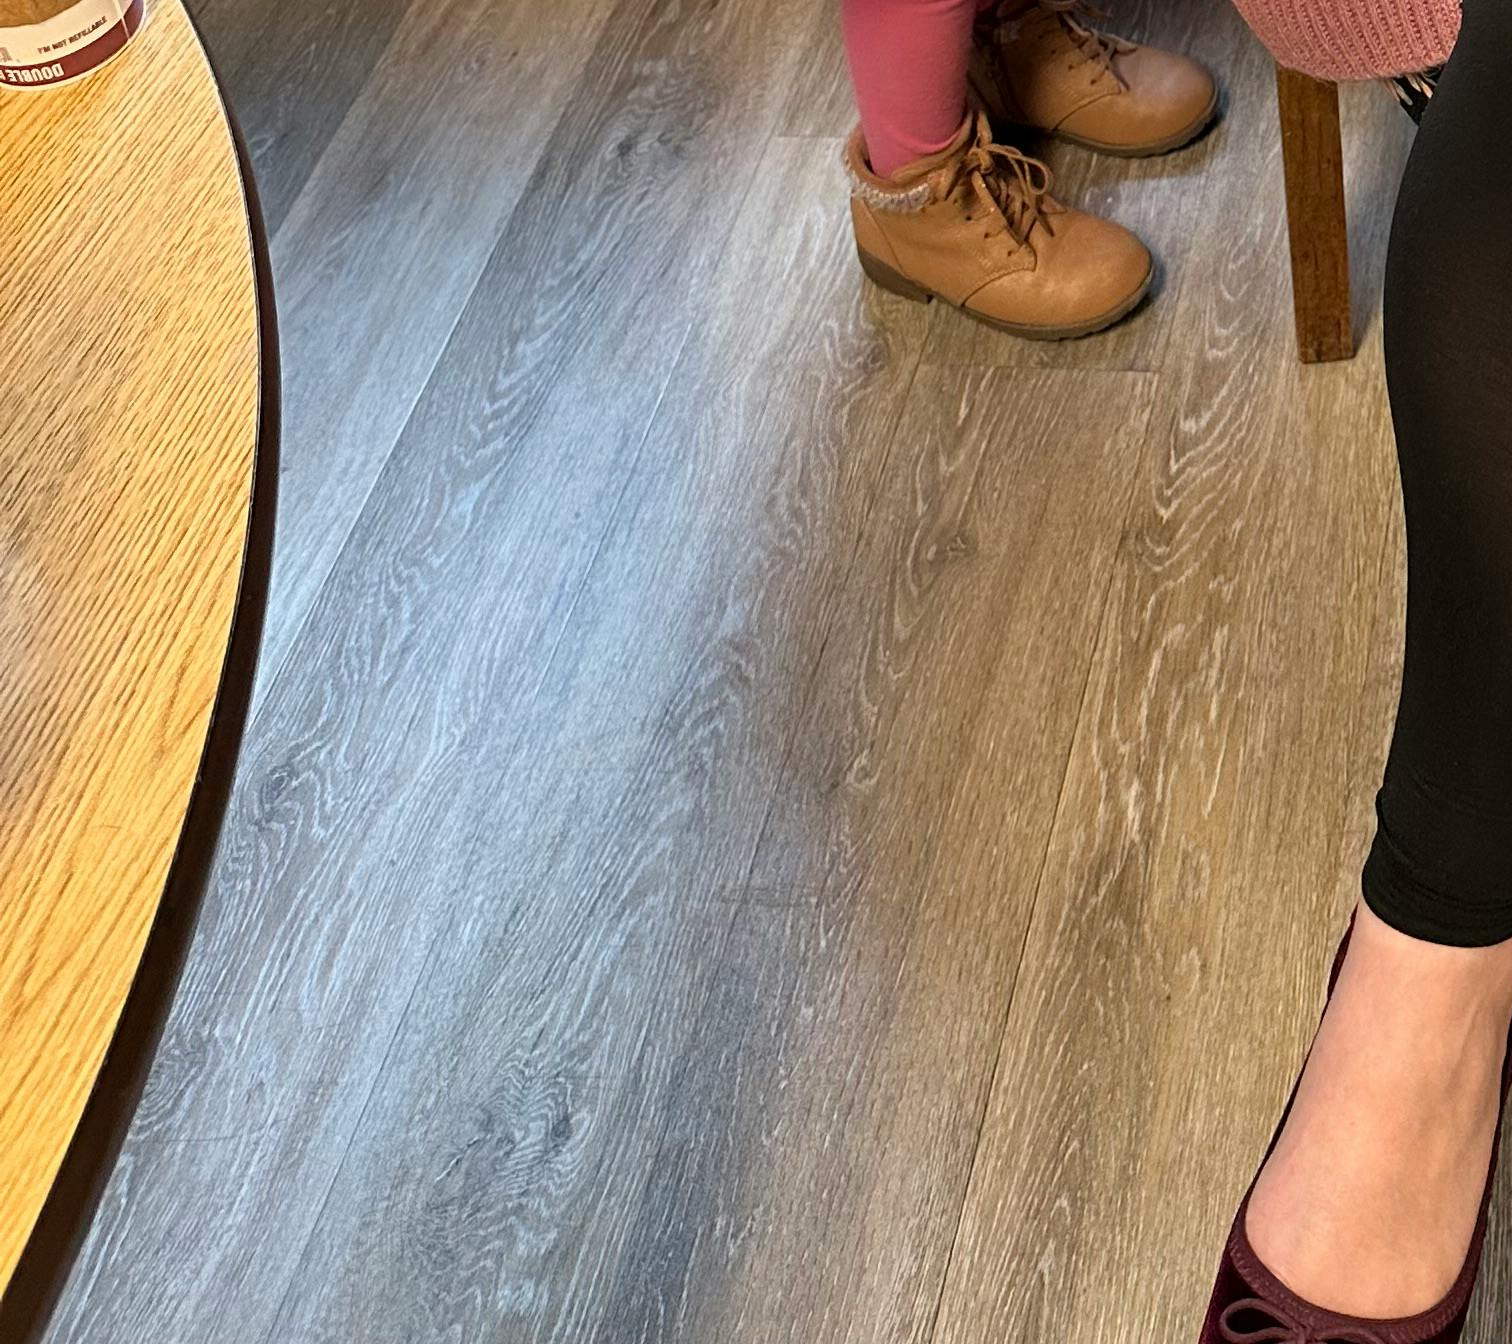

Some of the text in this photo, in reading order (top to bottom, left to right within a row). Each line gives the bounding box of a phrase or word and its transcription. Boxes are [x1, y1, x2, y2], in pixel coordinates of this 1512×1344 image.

[52, 39, 67, 50] NOT
[68, 15, 108, 44] REFILLABLE
[4, 63, 65, 82] DOUBLE
